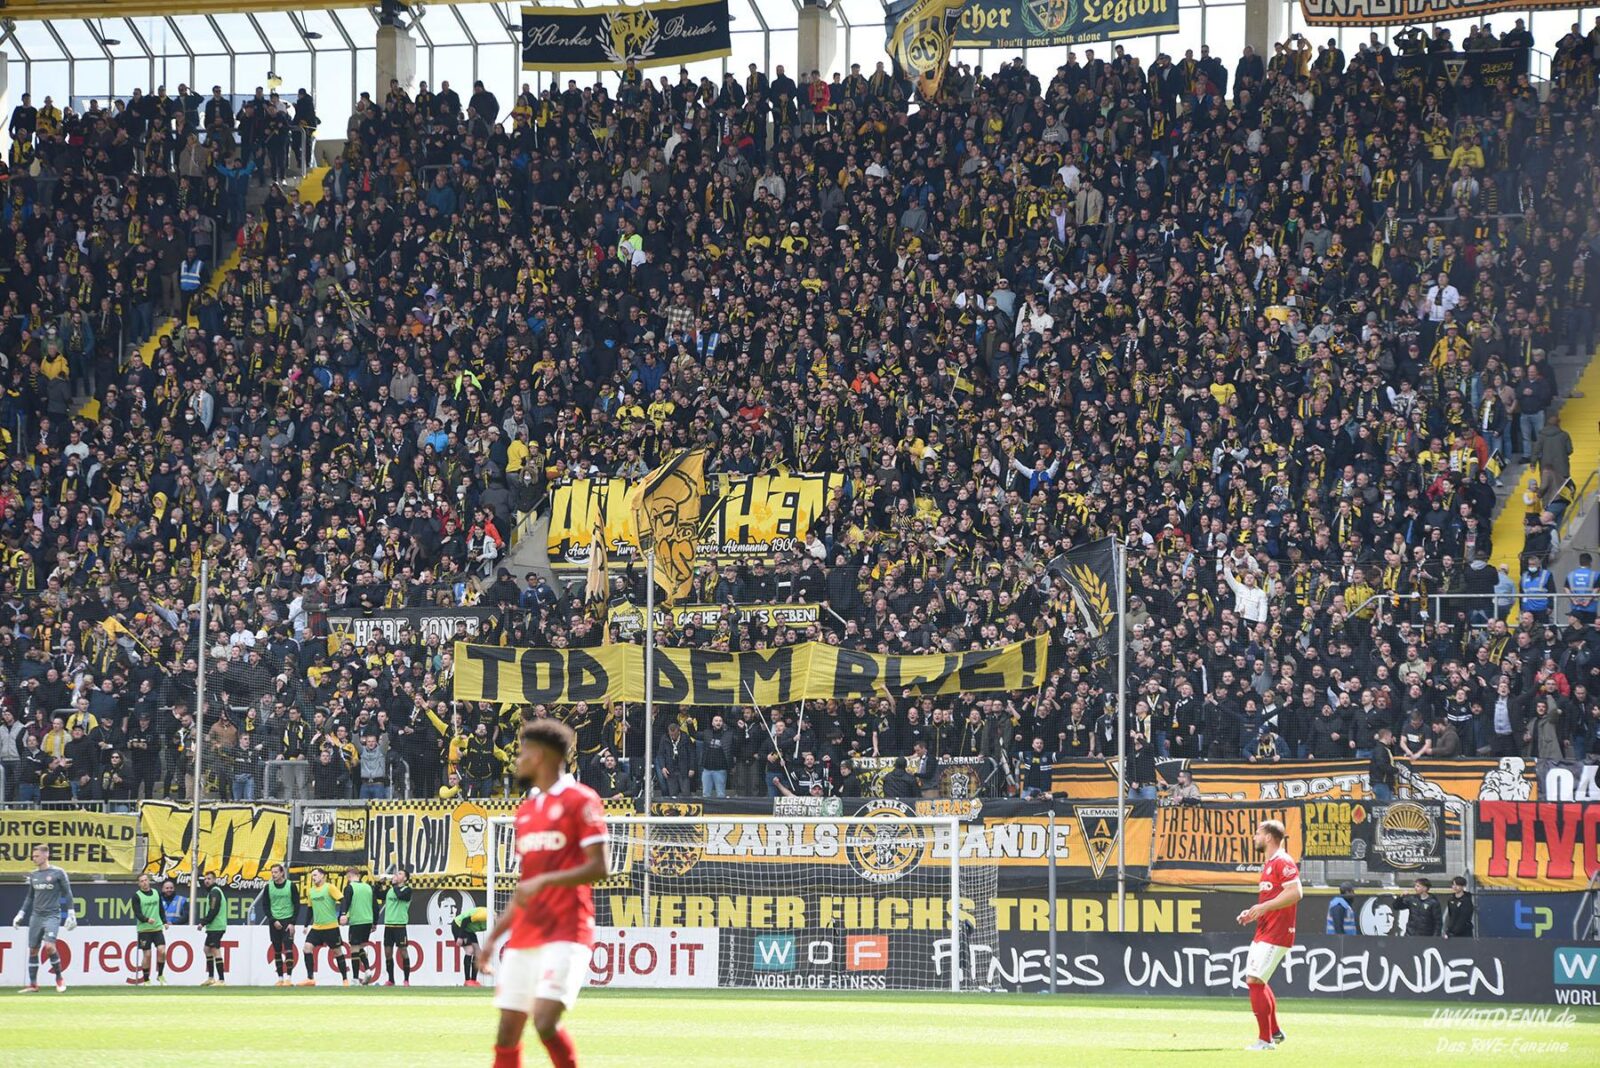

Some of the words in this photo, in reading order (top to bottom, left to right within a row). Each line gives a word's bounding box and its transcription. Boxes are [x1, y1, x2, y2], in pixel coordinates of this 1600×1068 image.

[1026, 38, 1049, 47] never
[1077, 32, 1101, 43] alone
[466, 645, 609, 704] TOD
[643, 647, 793, 704] DEM
[1304, 802, 1351, 824] PYRO
[369, 814, 451, 876] YELLOW
[705, 821, 839, 857] KARLS
[931, 823, 1070, 859] BANDE
[1305, 830, 1351, 846] KEIN
[1386, 848, 1425, 859] TIVOLI
[610, 895, 806, 929] WERNER
[820, 896, 976, 931] FUCHS
[989, 893, 1203, 933] TRIBÜNE
[83, 940, 194, 984] rego
[588, 930, 658, 985] gio
[670, 930, 704, 976] iT
[1280, 945, 1504, 996] FREUNDEN
[755, 974, 803, 989] WORLD
[807, 974, 825, 989] OF
[829, 974, 886, 990] FITNESS
